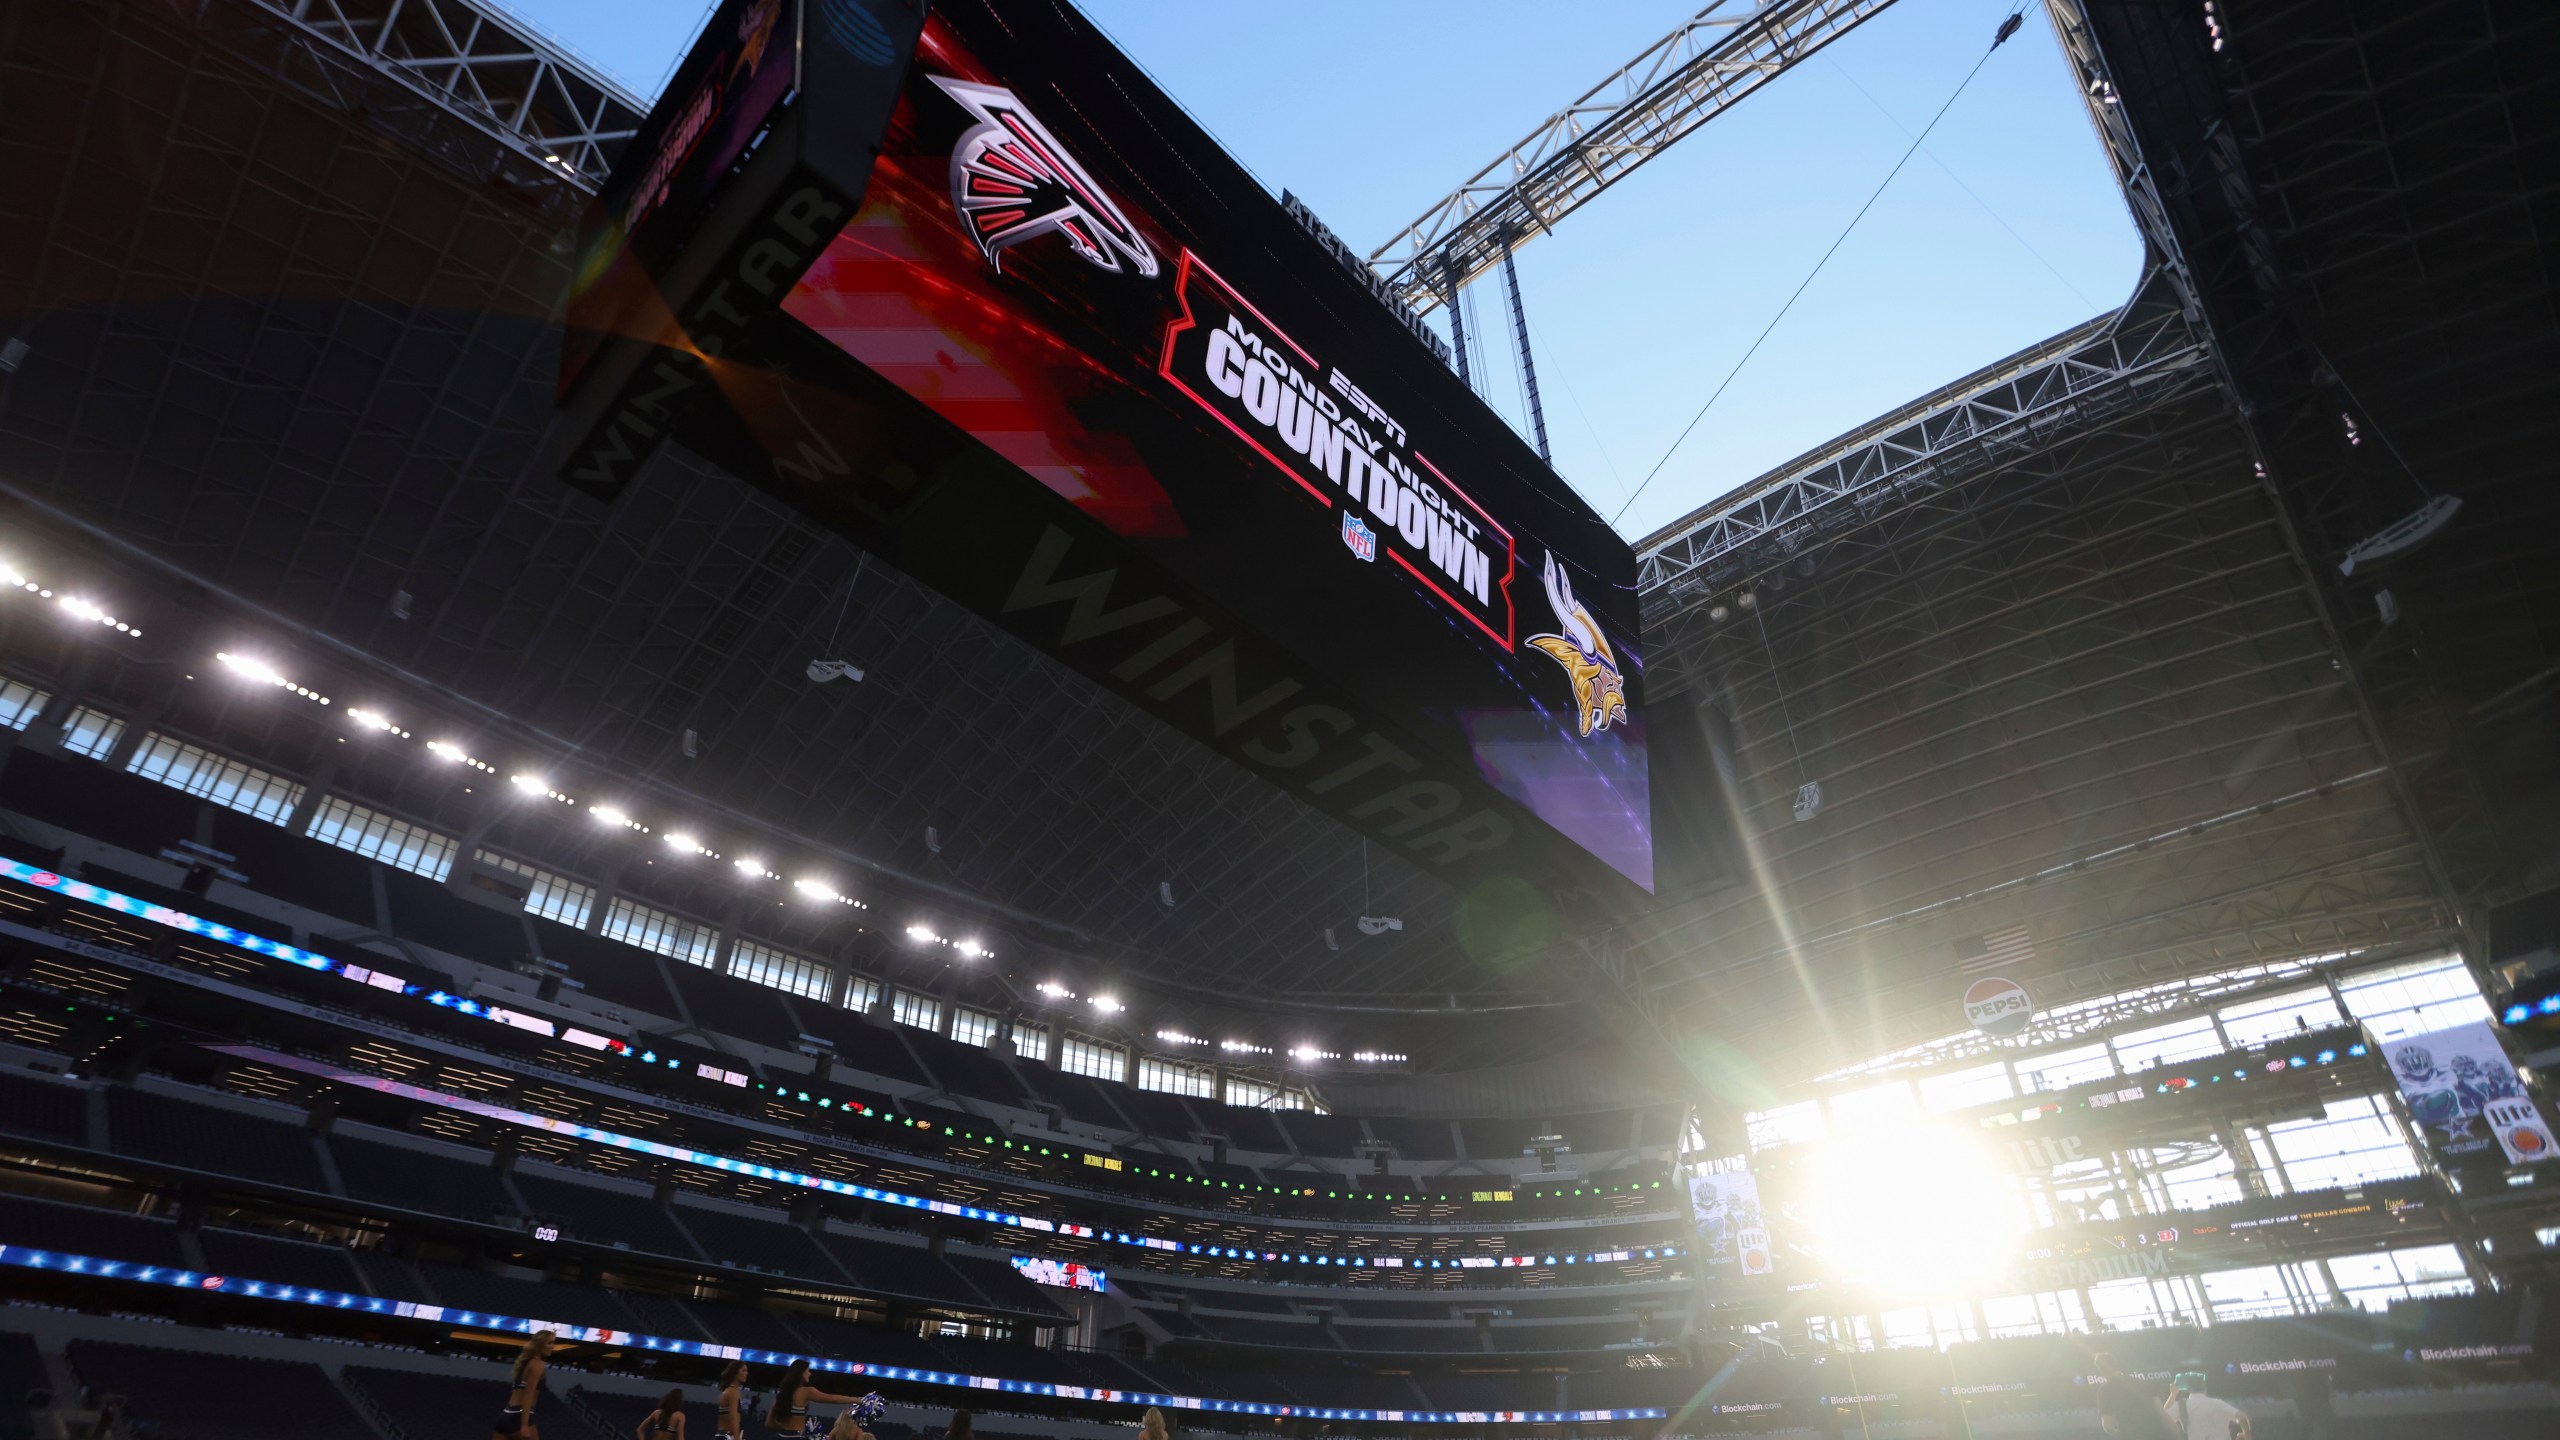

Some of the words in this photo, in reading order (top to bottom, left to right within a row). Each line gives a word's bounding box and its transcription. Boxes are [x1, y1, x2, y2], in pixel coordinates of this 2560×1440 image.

[1285, 196, 1349, 264] AT&T
[1352, 256, 1452, 370] STADIUM
[572, 185, 843, 484] WINSTAR
[1328, 366, 1406, 448] ESPN
[1226, 313, 1386, 454] MONDAY
[1387, 448, 1482, 540] NIGHT
[1205, 328, 1490, 607] COUNTDOWN
[1346, 524, 1373, 560] NFL
[1000, 522, 1514, 878] WINSTAR
[1967, 994, 2028, 1020] PEPSI
[2489, 1105, 2533, 1127] Lite
[2230, 1220, 2258, 1229] OFFICIAL
[2259, 1217, 2275, 1226] GOLF
[2275, 1215, 2290, 1223] CAR
[2299, 1212, 2312, 1220] THE
[2313, 1209, 2338, 1219] DALLAS
[2338, 1205, 2371, 1215] COWBOYS
[535, 1227, 558, 1242] 0:00
[1477, 1224, 1506, 1232] PEARSON
[1739, 1232, 1764, 1249] Lite
[2137, 1233, 2147, 1245] 3
[2026, 1247, 2051, 1260] 0:00
[2047, 1248, 2170, 1287] STADIUM
[1786, 1282, 1817, 1292] American
[2420, 1344, 2533, 1361] Blockchain.com
[2239, 1358, 2336, 1374] Blockchain.com
[2086, 1371, 2172, 1385] Bloin.com
[1951, 1382, 2026, 1396] Blockchain.com
[1830, 1392, 1897, 1405] Blockchain.com
[1721, 1402, 1782, 1413] Blockchain.com
